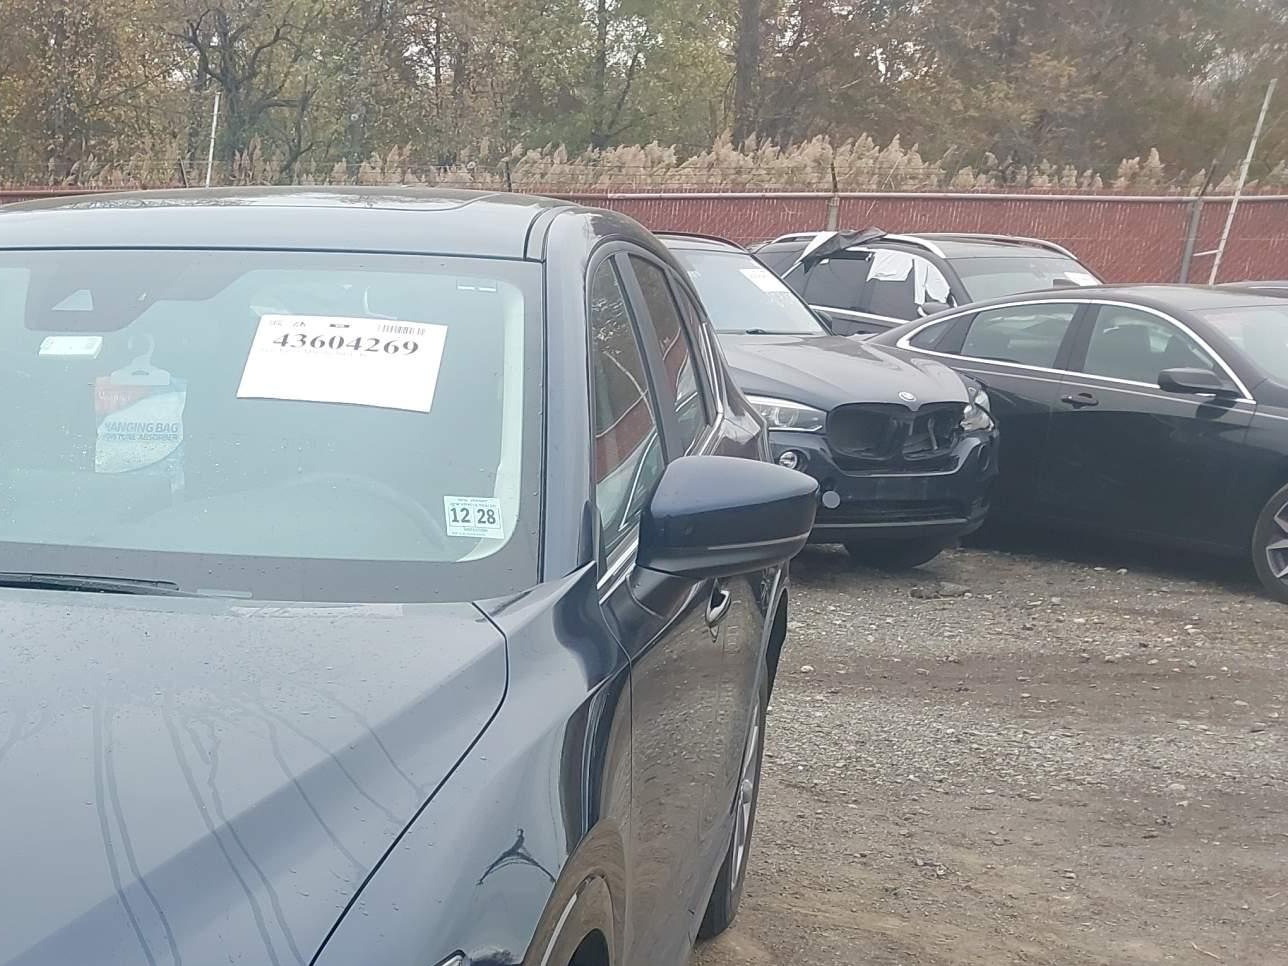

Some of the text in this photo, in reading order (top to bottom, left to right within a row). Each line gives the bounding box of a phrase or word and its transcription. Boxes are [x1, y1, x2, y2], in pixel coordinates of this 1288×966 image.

[273, 333, 419, 355] 43604269
[156, 422, 178, 433] BAG
[450, 508, 497, 525] 12 28
